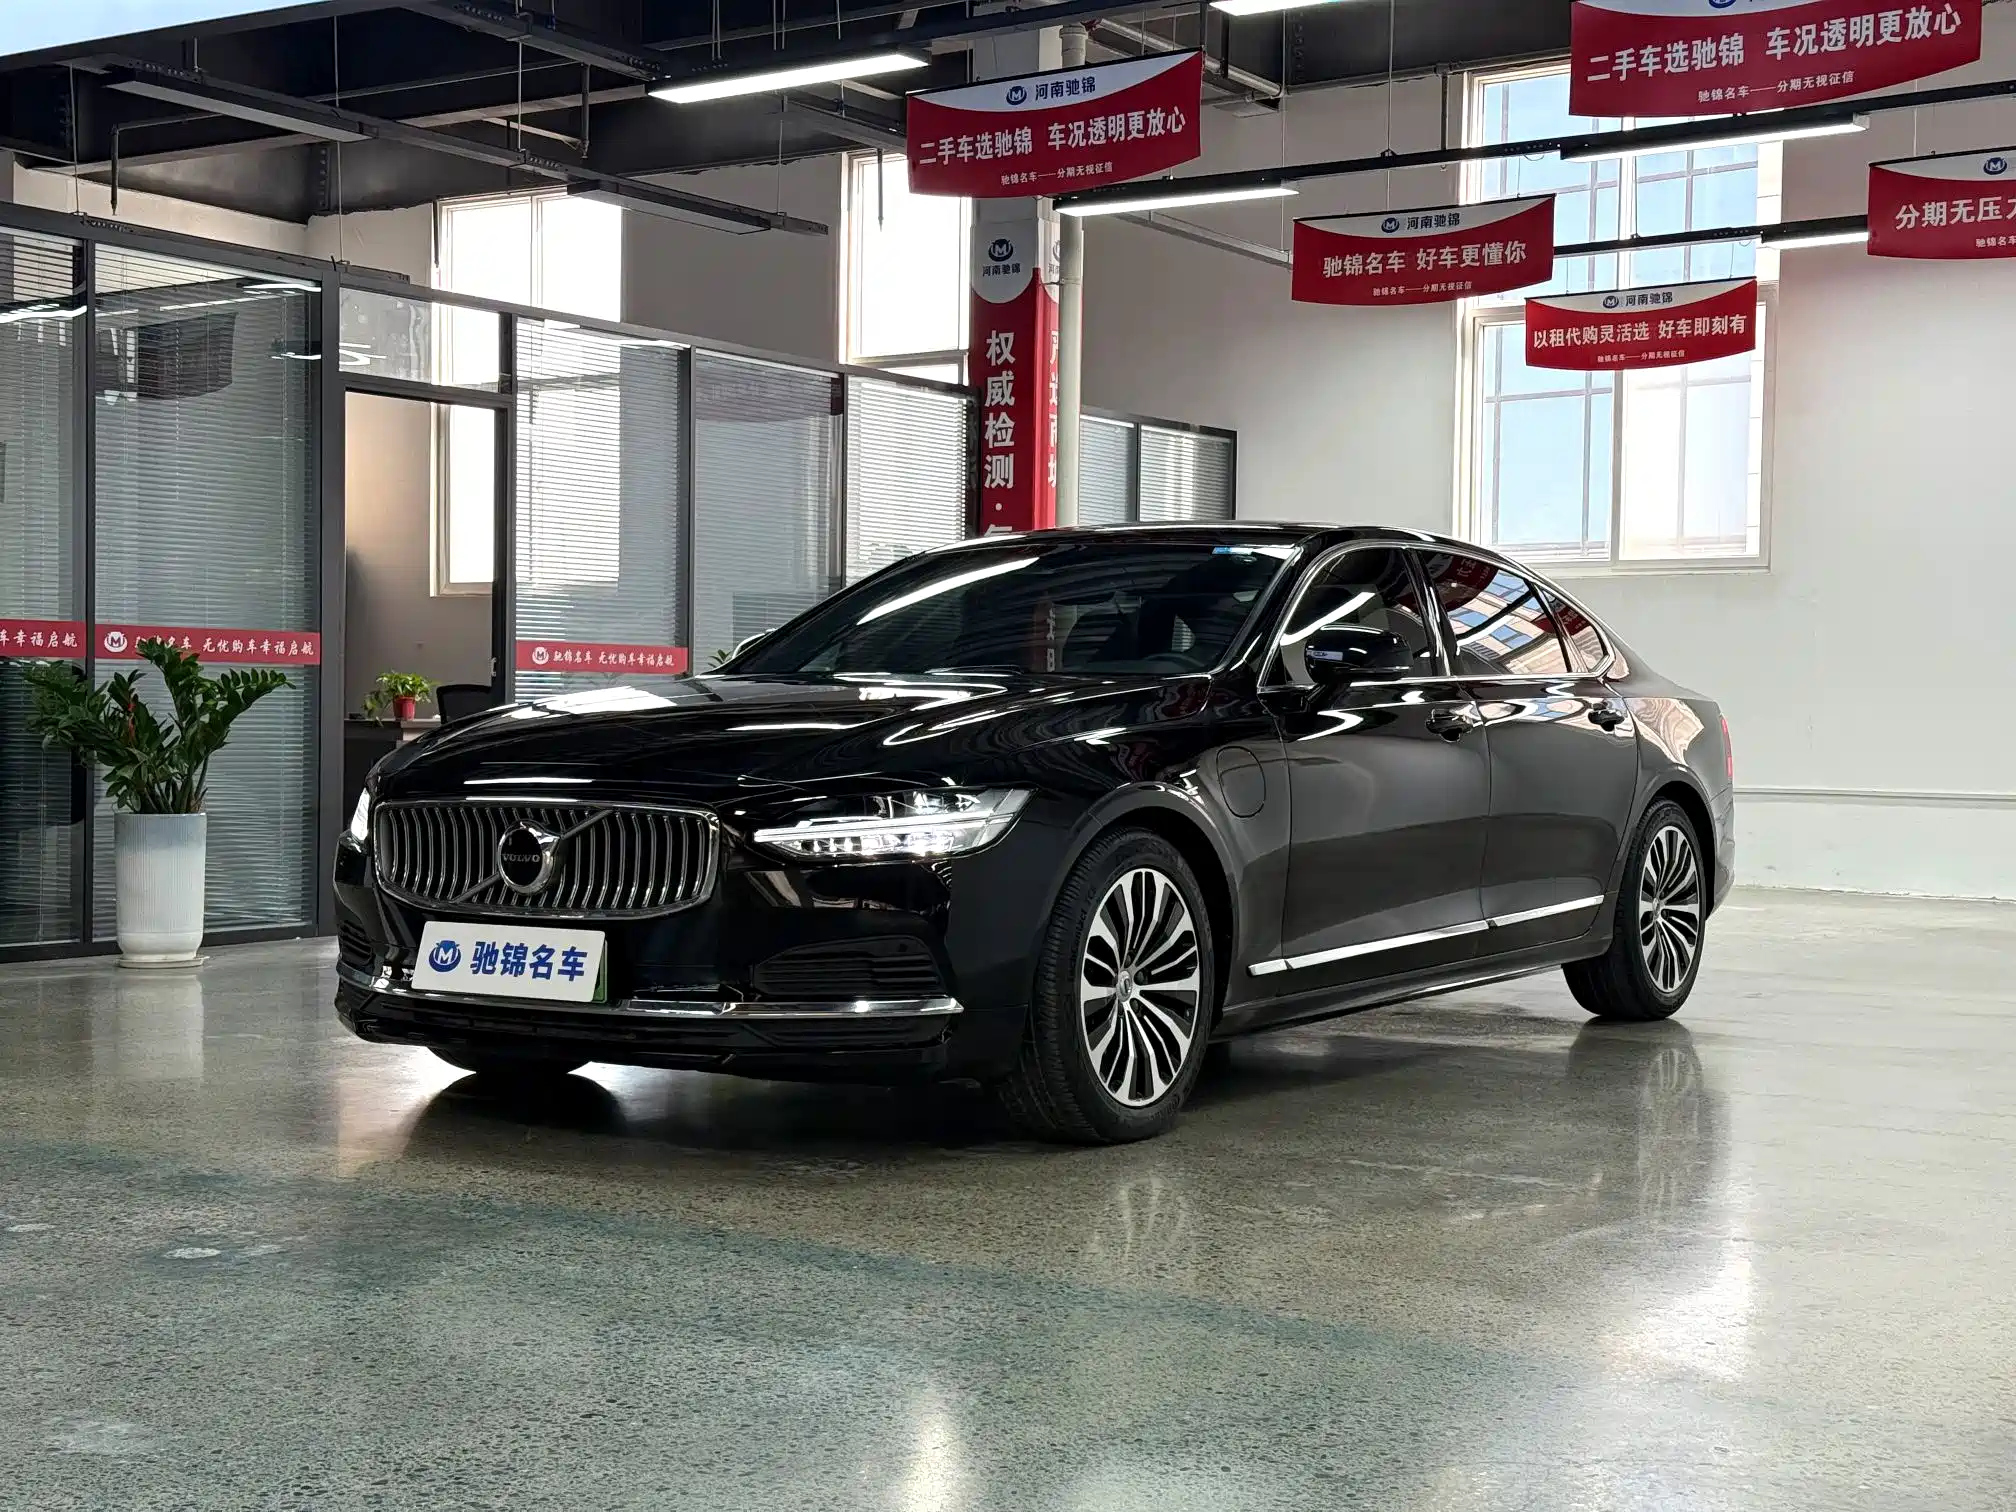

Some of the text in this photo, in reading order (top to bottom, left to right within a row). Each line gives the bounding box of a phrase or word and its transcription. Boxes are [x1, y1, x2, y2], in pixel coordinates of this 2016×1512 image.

[1587, 3, 1962, 82] 二手车选驰锦 车况透明更放心
[1035, 77, 1096, 101] 河南驰锦
[919, 105, 1186, 165] 二手车选驰锦 车况透明更放心
[1406, 213, 1460, 231] 河南驰锦
[982, 263, 1021, 277] 河南驰锦
[1323, 240, 1527, 278] 驰锦名车 好车更懂你
[1625, 291, 1673, 307] 河南驰锦
[1533, 313, 1747, 349] 以租代购灵活选 好车即刻有
[501, 853, 541, 863] VOLVO
[469, 941, 588, 982] 驰锦名车
